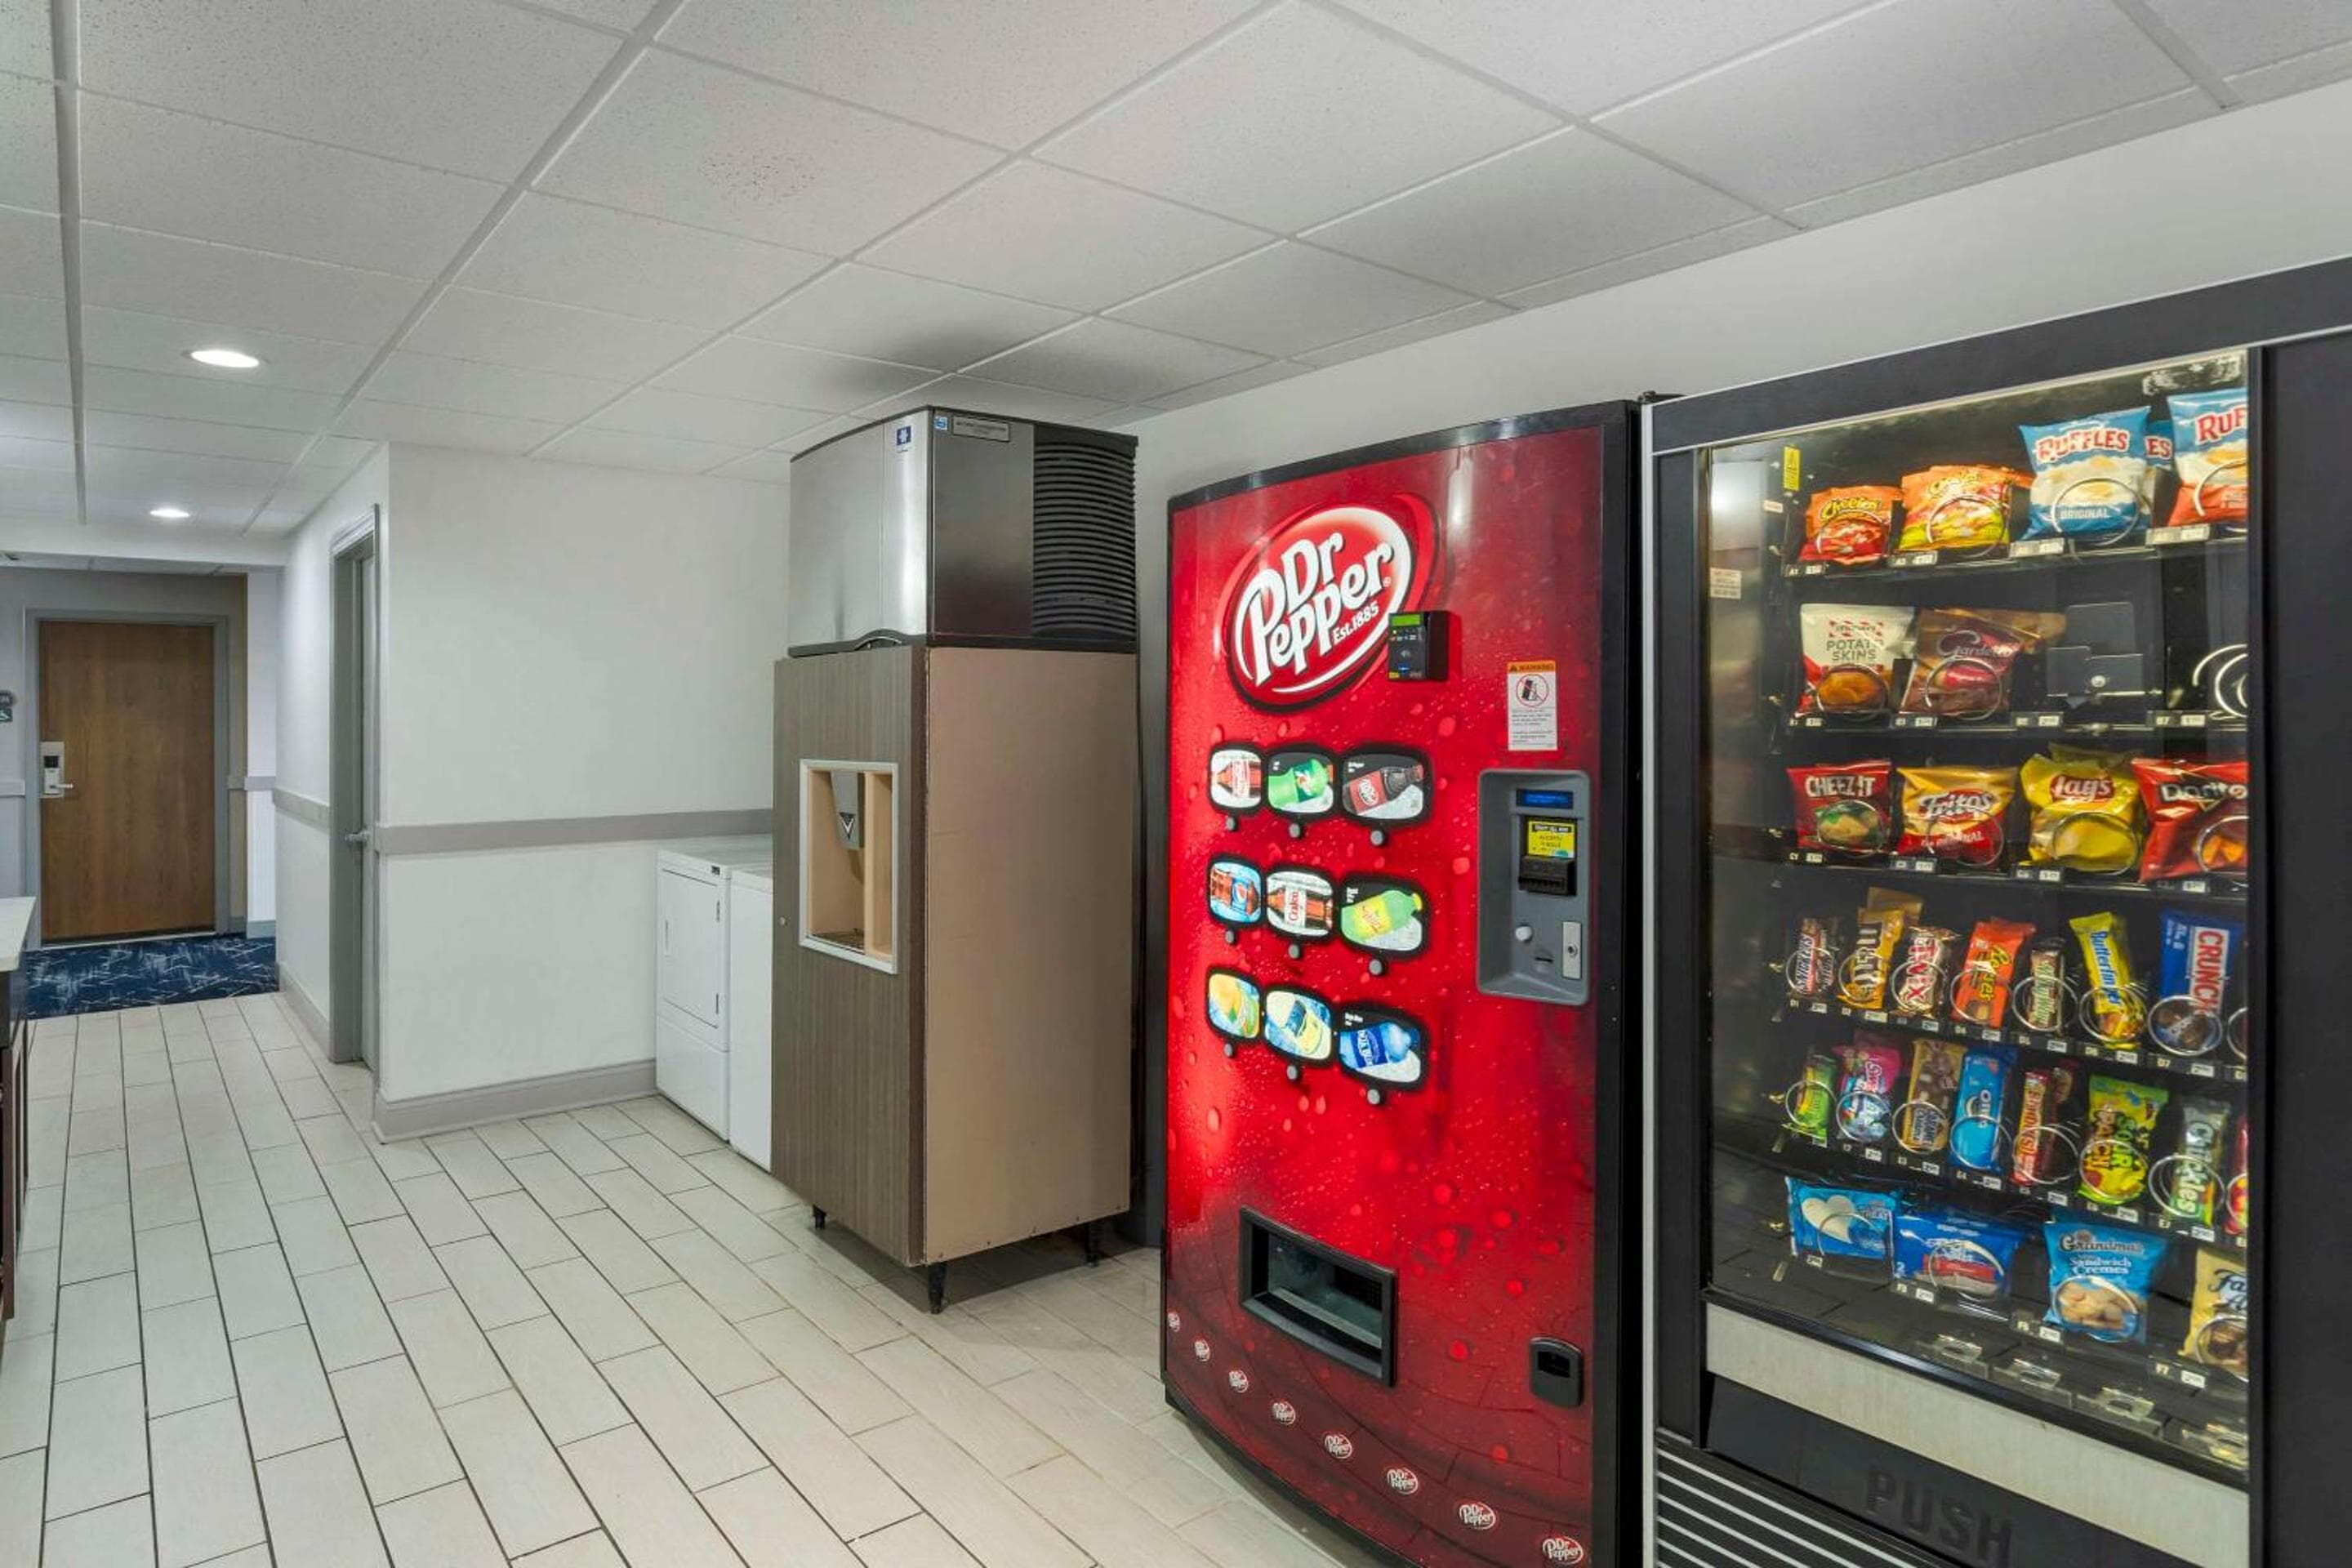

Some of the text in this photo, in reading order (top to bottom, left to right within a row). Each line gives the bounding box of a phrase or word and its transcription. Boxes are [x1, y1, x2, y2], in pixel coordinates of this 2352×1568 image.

[2036, 429, 2129, 461] RUFFLES
[1820, 497, 1881, 521] Cheetos
[2059, 508, 2110, 520] ORIGINAL
[1281, 532, 1343, 614] Dr
[1235, 542, 1393, 686] Pepper
[1832, 652, 1877, 662] SKINS
[2051, 776, 2114, 803] Lay's
[1918, 791, 1996, 820] Fritos
[1907, 943, 1939, 1001] TWIX
[2113, 1115, 2135, 1167] SOUR
[2176, 1123, 2216, 1214] Chuckles
[2069, 1257, 2132, 1267] Sandwich
[2071, 1266, 2130, 1275] Cremes
[1867, 1467, 2013, 1568] PUSH
[1543, 1538, 1584, 1561] Pepper
